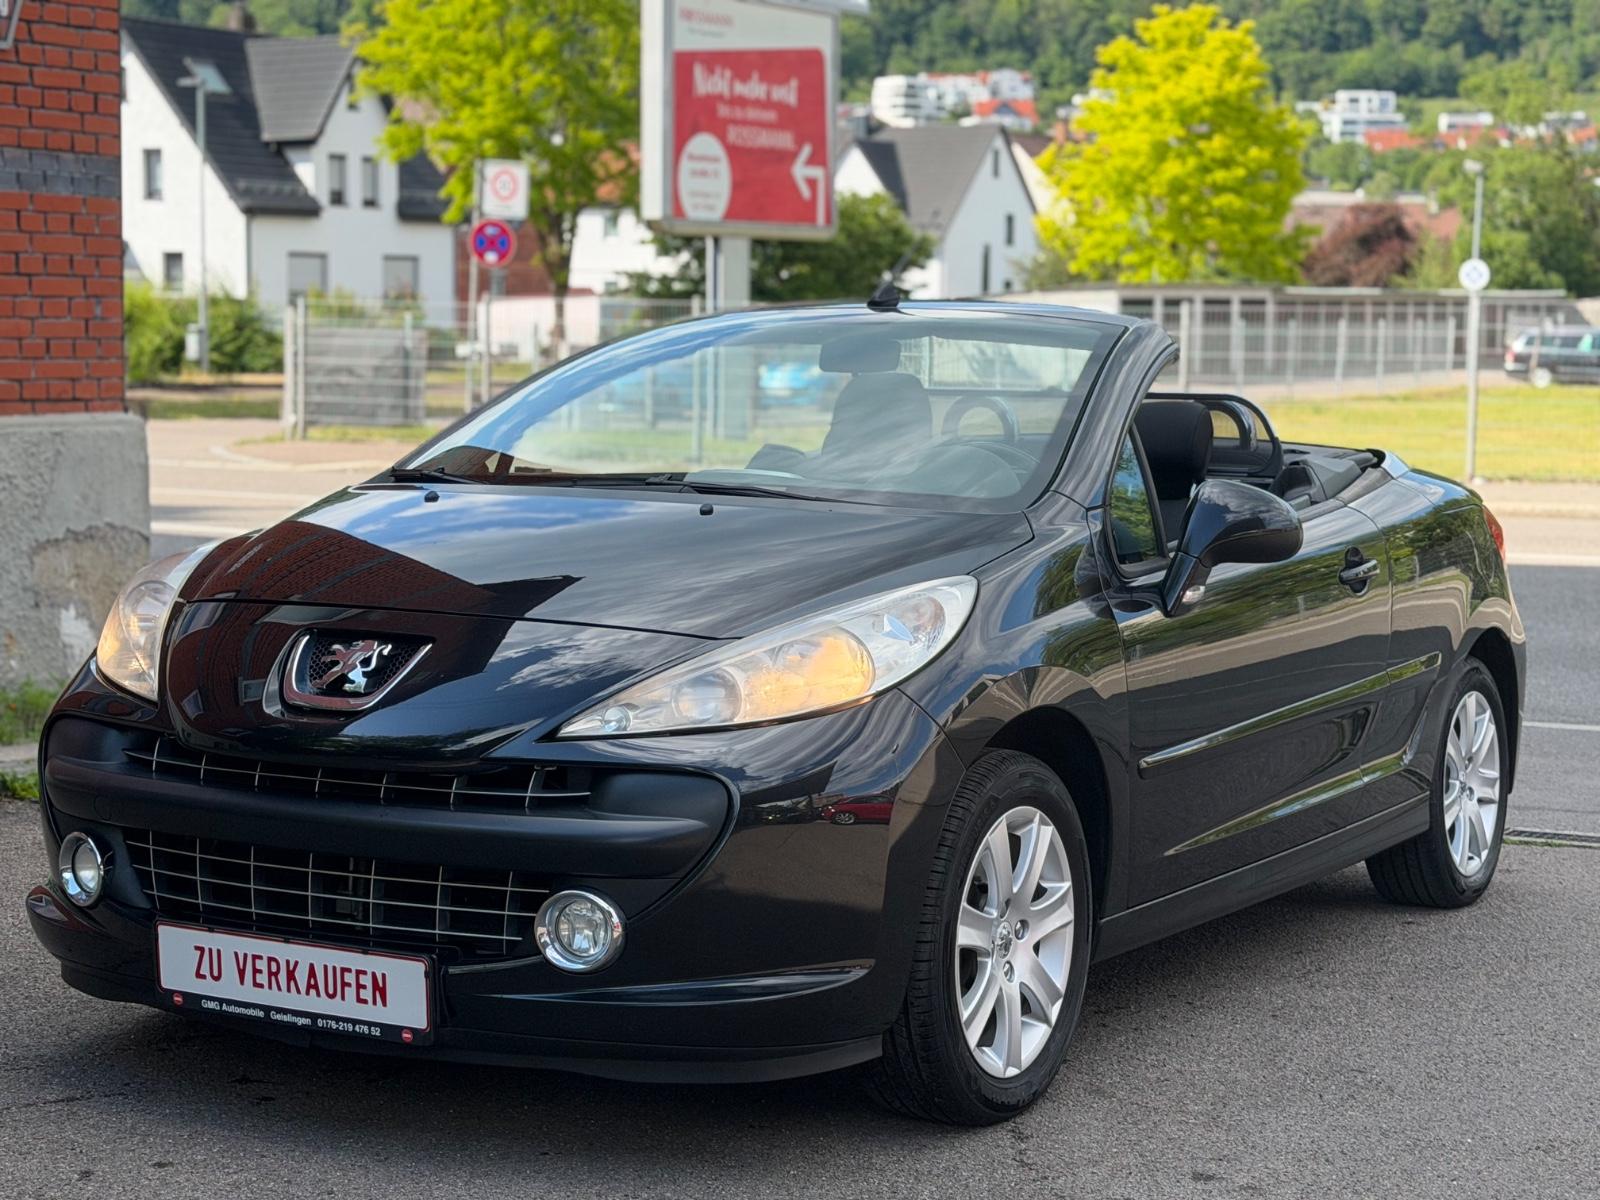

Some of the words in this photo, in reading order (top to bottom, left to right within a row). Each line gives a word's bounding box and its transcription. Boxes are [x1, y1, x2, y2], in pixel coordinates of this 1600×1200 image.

[194, 945, 222, 982] ZU
[234, 951, 388, 1007] VERKAUFEN
[201, 999, 220, 1010] GMG
[222, 1003, 265, 1017] Automobile
[270, 1011, 312, 1025] Geislingen
[317, 1018, 353, 1031] 0176-219
[354, 1024, 369, 1034] 476
[370, 1027, 381, 1036] 52
